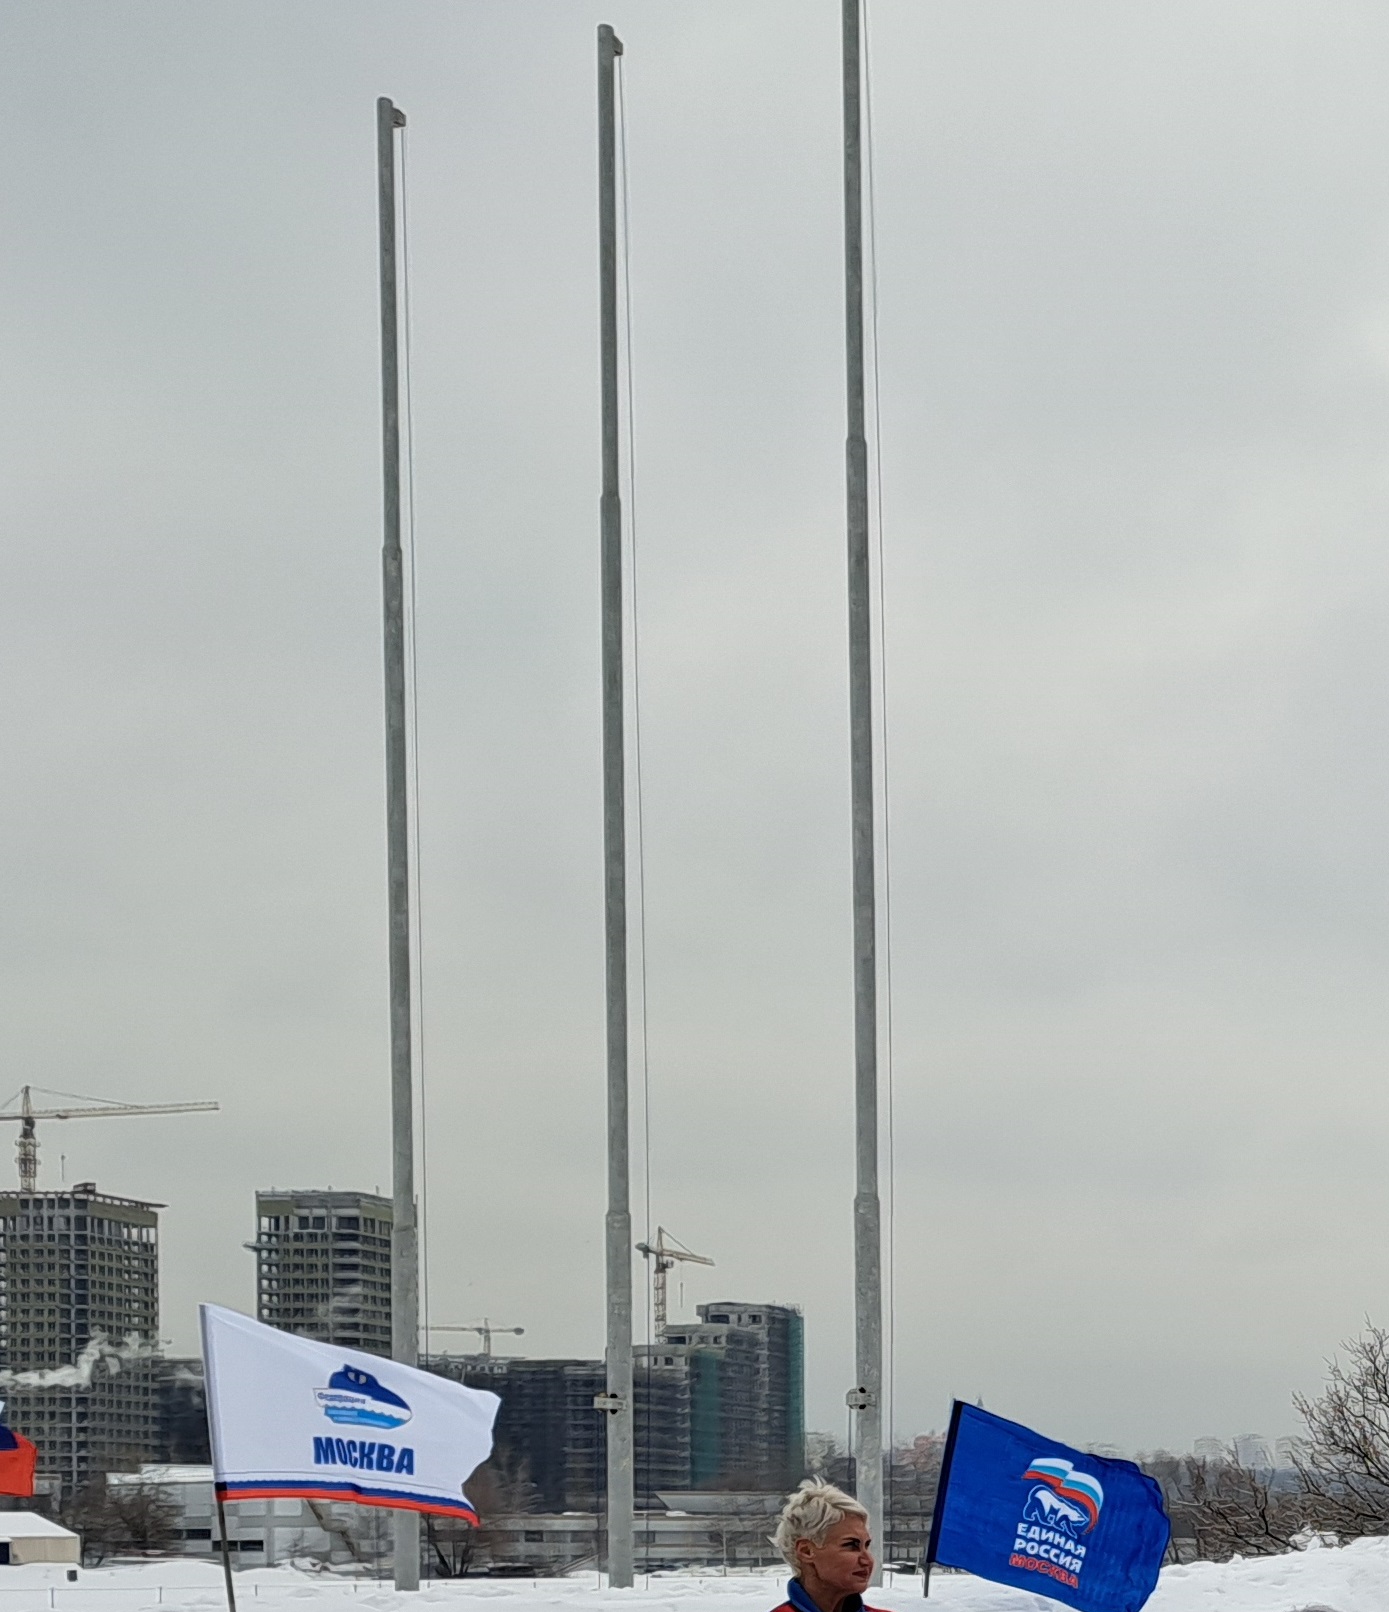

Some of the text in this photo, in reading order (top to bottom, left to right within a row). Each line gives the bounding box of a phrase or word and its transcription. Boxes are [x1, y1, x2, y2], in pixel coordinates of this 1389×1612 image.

[312, 1436, 414, 1475] МОСКВА
[1013, 1537, 1083, 1574] РОССИЯ
[1016, 1522, 1087, 1558] ЕДИНАЯ
[1009, 1552, 1079, 1589] МОСКВА
